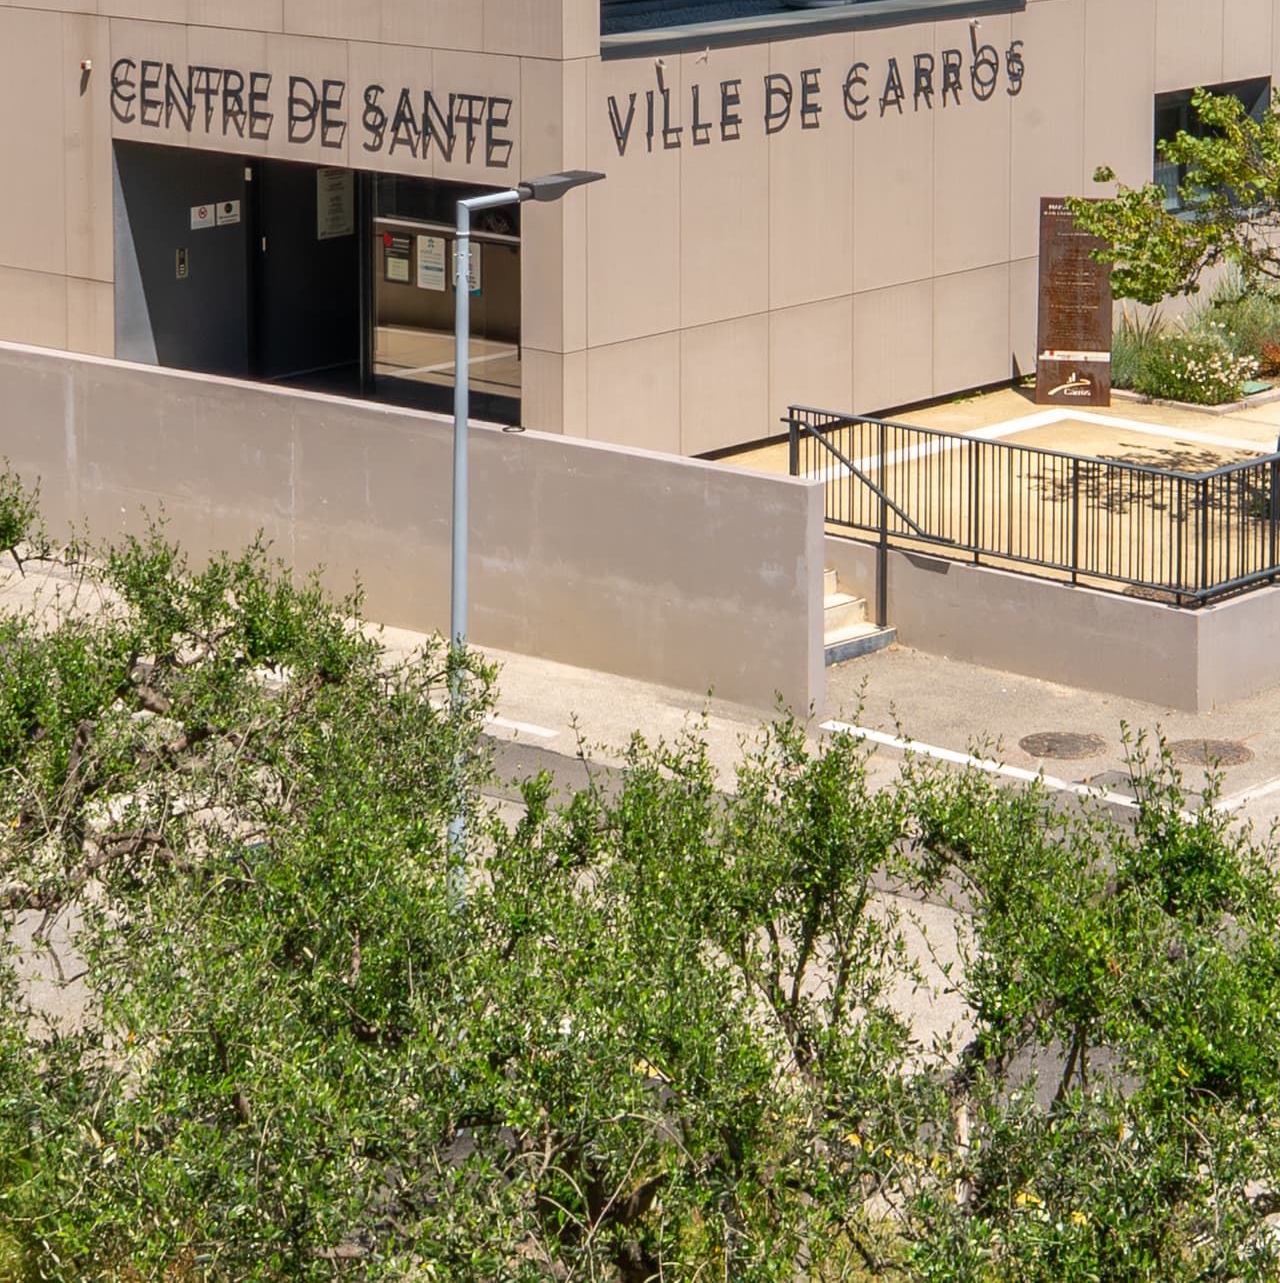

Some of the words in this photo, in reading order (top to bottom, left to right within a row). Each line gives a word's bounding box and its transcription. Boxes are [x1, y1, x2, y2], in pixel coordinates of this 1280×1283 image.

[111, 58, 273, 130] CENTRE
[288, 76, 345, 138] DE
[362, 84, 512, 158] SANTE
[608, 79, 742, 148] VILLE
[764, 68, 822, 128] DE
[843, 40, 1025, 114] CARROS
